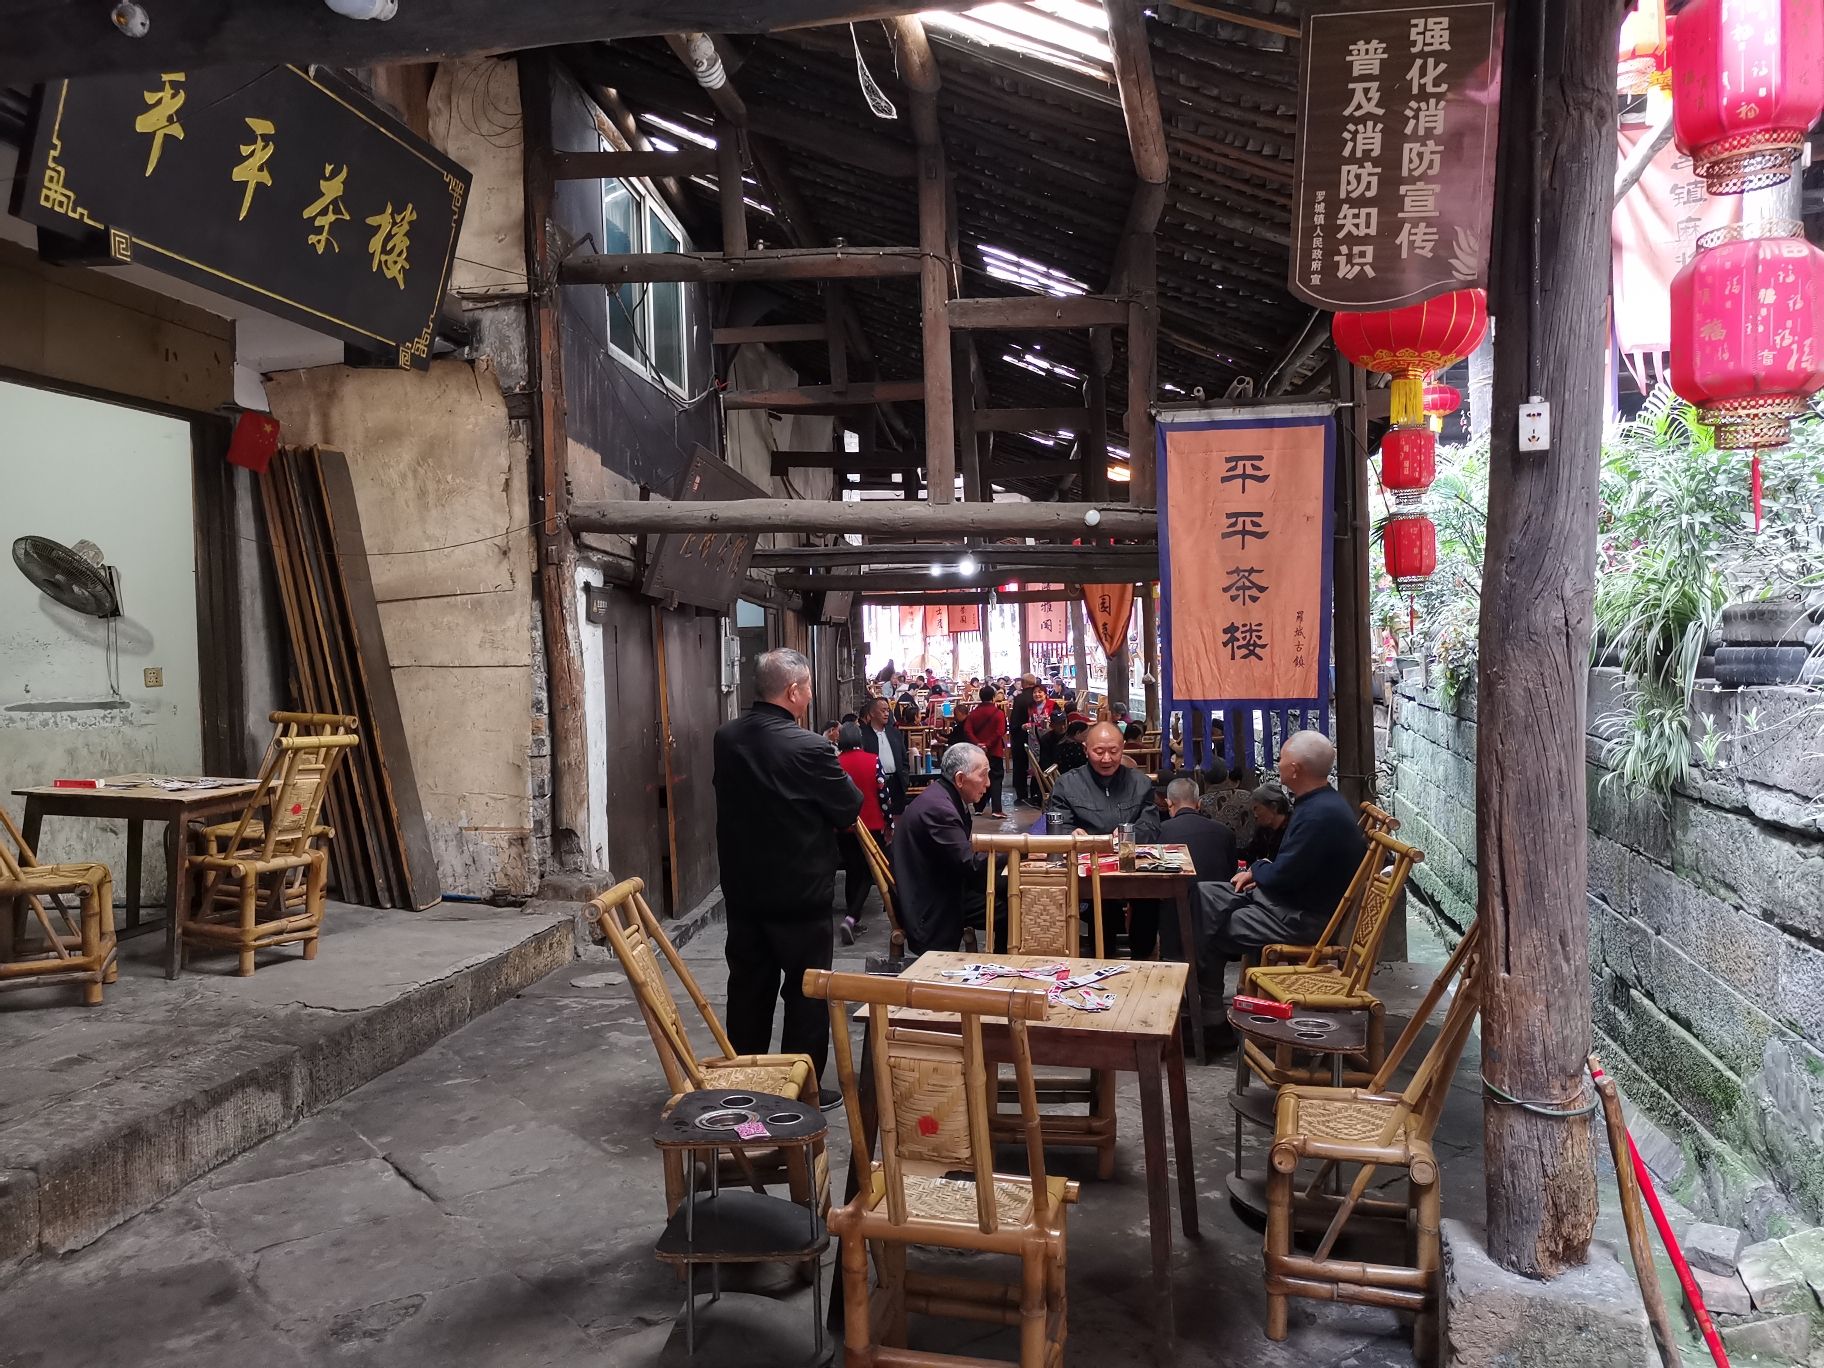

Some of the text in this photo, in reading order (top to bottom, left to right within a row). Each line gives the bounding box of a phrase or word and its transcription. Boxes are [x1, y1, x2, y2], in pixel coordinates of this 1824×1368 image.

[1333, 38, 1389, 281] 普及消防知识
[1395, 16, 1452, 260] 强化消防宣传
[1220, 454, 1271, 662] 平平茶楼
